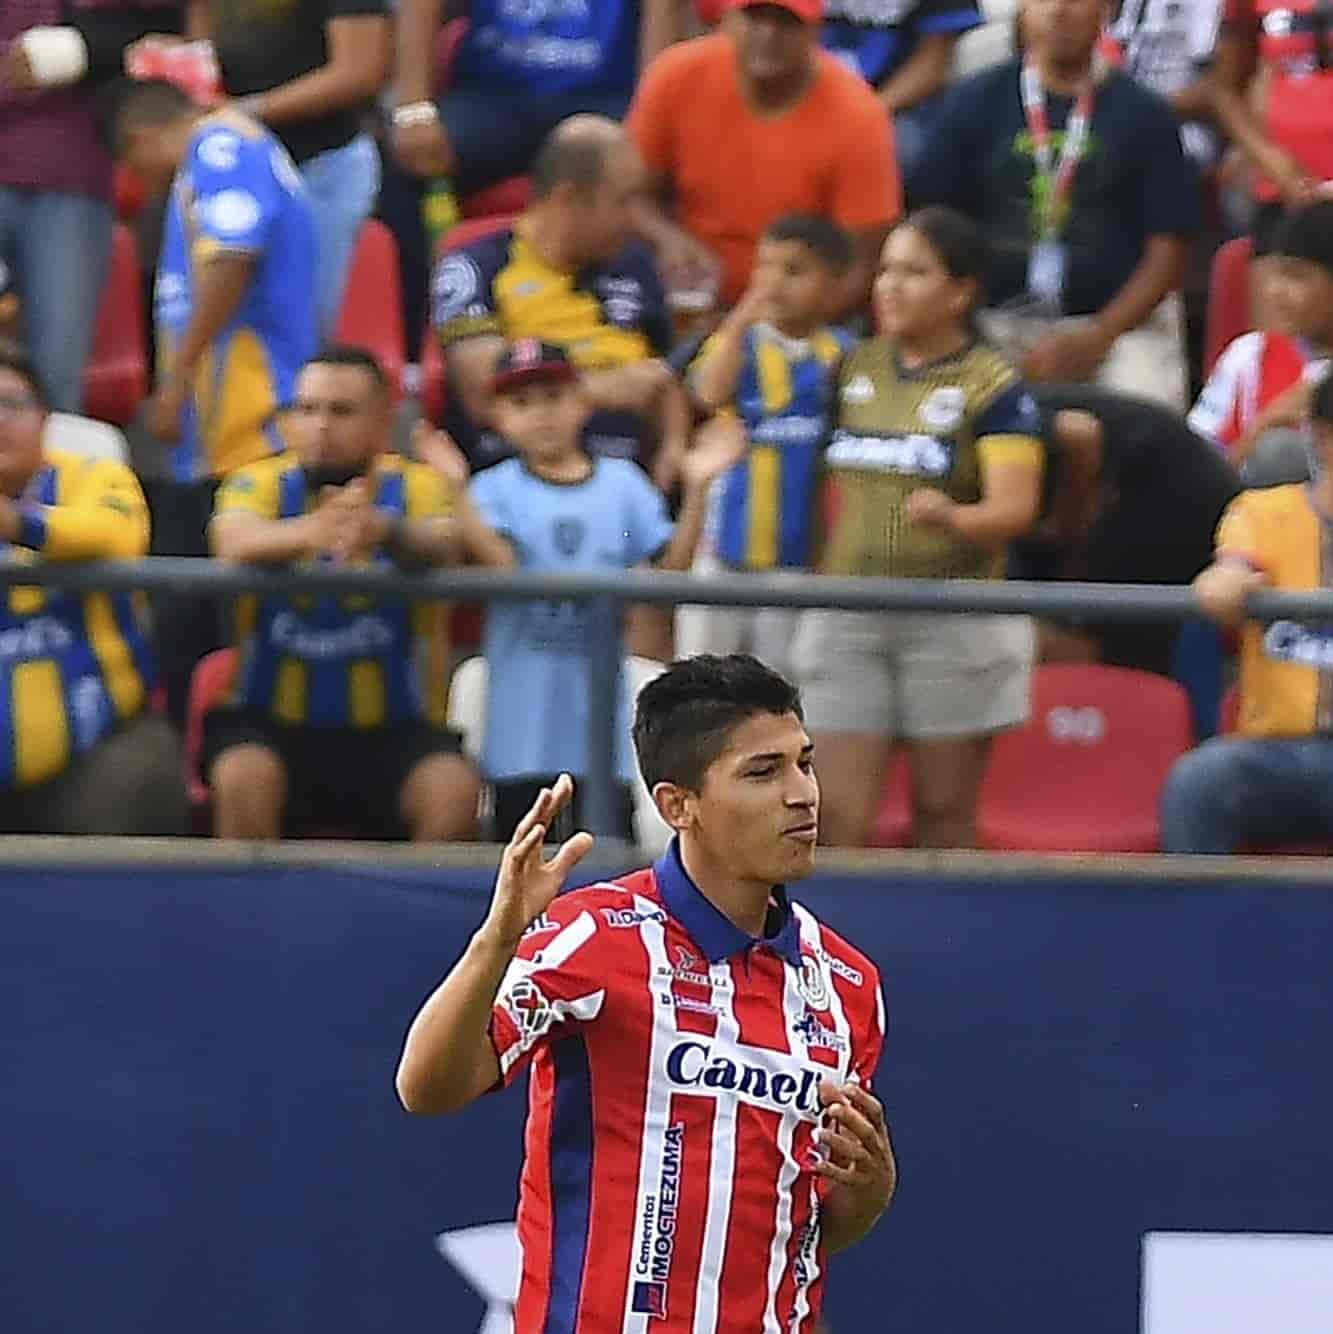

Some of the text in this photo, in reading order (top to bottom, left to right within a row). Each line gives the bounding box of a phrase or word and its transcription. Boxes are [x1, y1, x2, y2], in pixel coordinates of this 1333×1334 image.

[666, 1041, 827, 1116] Canel'
[635, 1194, 656, 1275] Cementos
[651, 1126, 683, 1279] MOCTEZUMA
